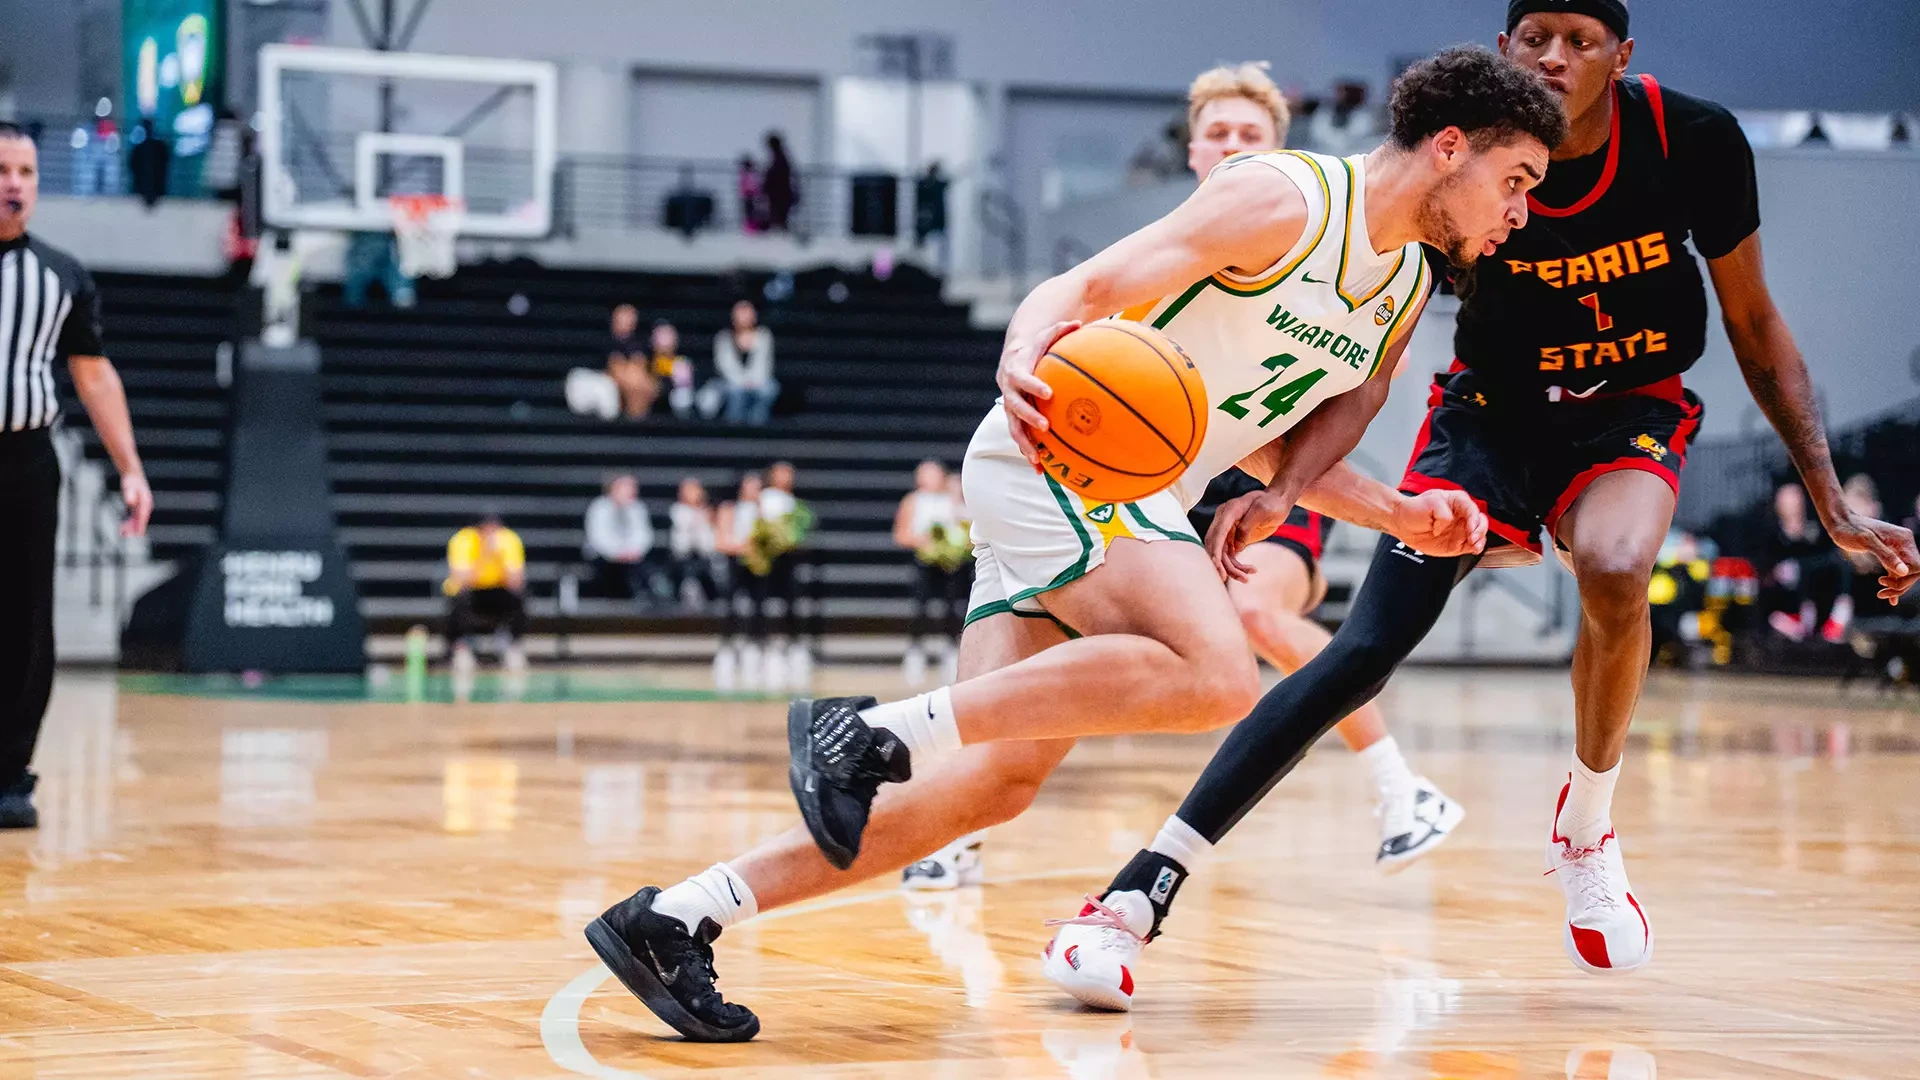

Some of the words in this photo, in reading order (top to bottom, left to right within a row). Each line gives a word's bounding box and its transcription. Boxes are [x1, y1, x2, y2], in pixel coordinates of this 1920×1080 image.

[1503, 231, 1671, 288] FERRIS
[1266, 303, 1370, 370] WARRORS
[1577, 292, 1613, 331] 1
[1539, 328, 1667, 371] STATE
[1216, 352, 1329, 429] 24
